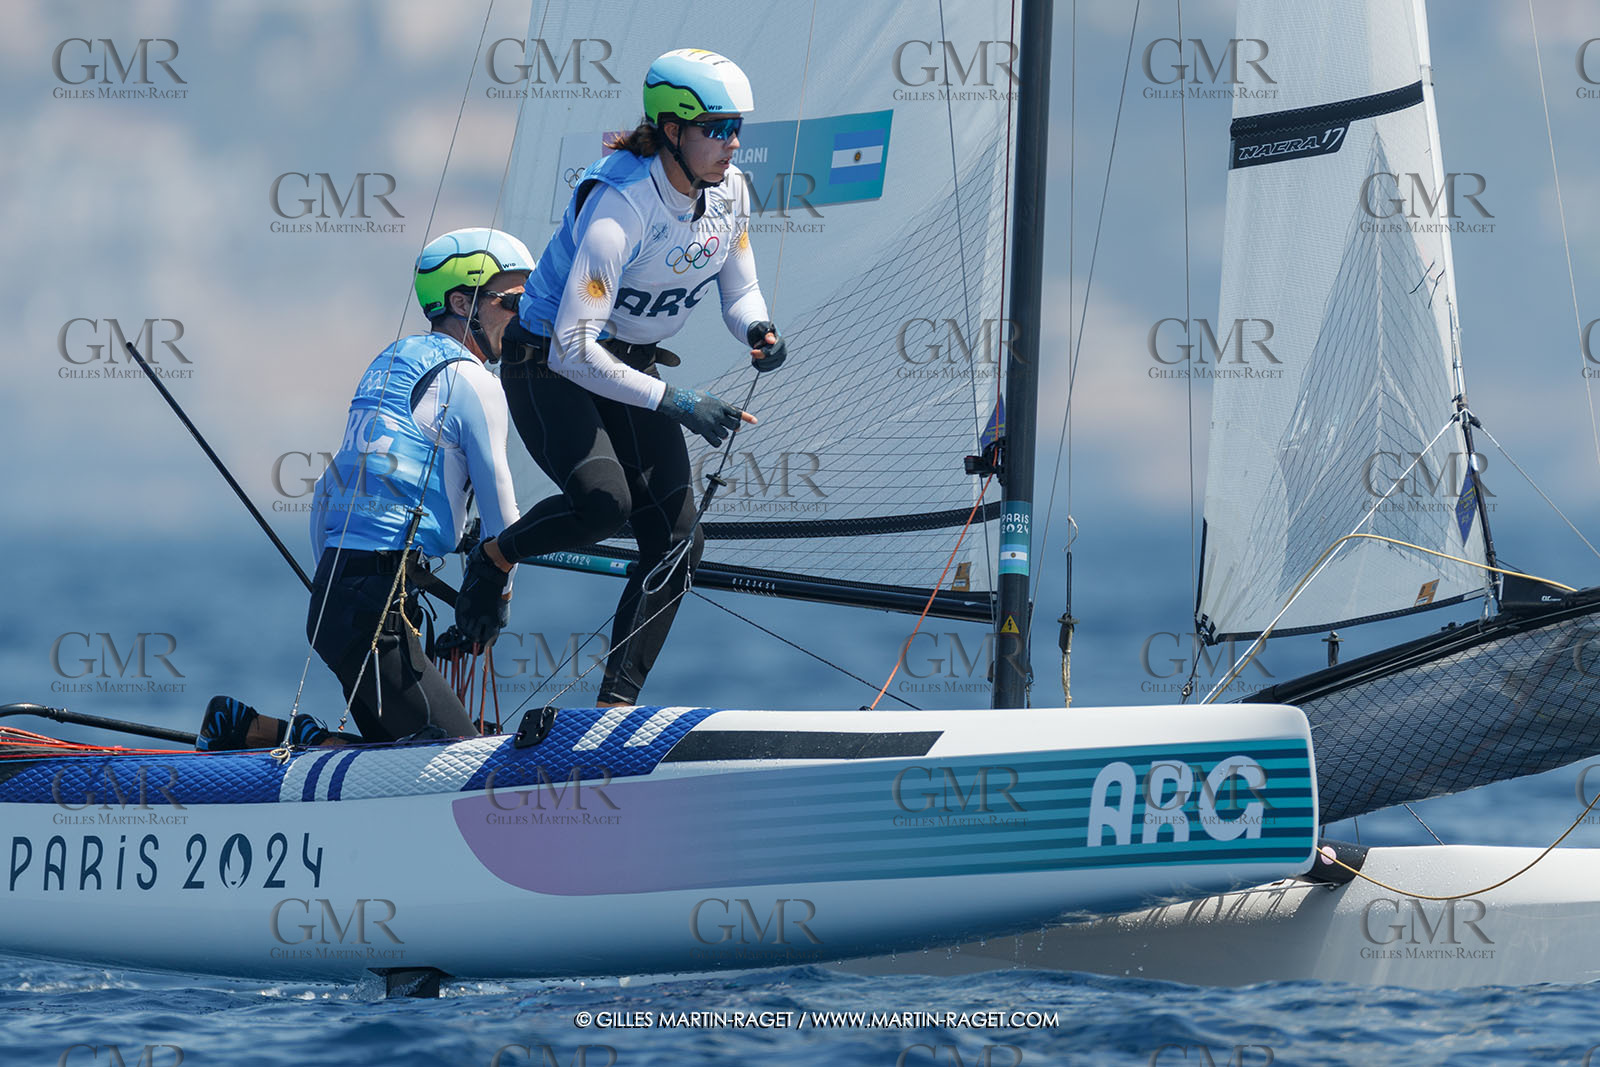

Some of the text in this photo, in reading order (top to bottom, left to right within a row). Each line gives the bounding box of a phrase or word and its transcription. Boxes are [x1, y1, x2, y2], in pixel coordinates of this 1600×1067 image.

[730, 147, 768, 164] ALANI
[1239, 127, 1345, 160] NACRA 17
[343, 409, 398, 456] RG
[1002, 524, 1028, 534] 2024
[566, 554, 592, 566] 2024
[1087, 755, 1267, 847] ARG
[182, 832, 323, 889] 2024
